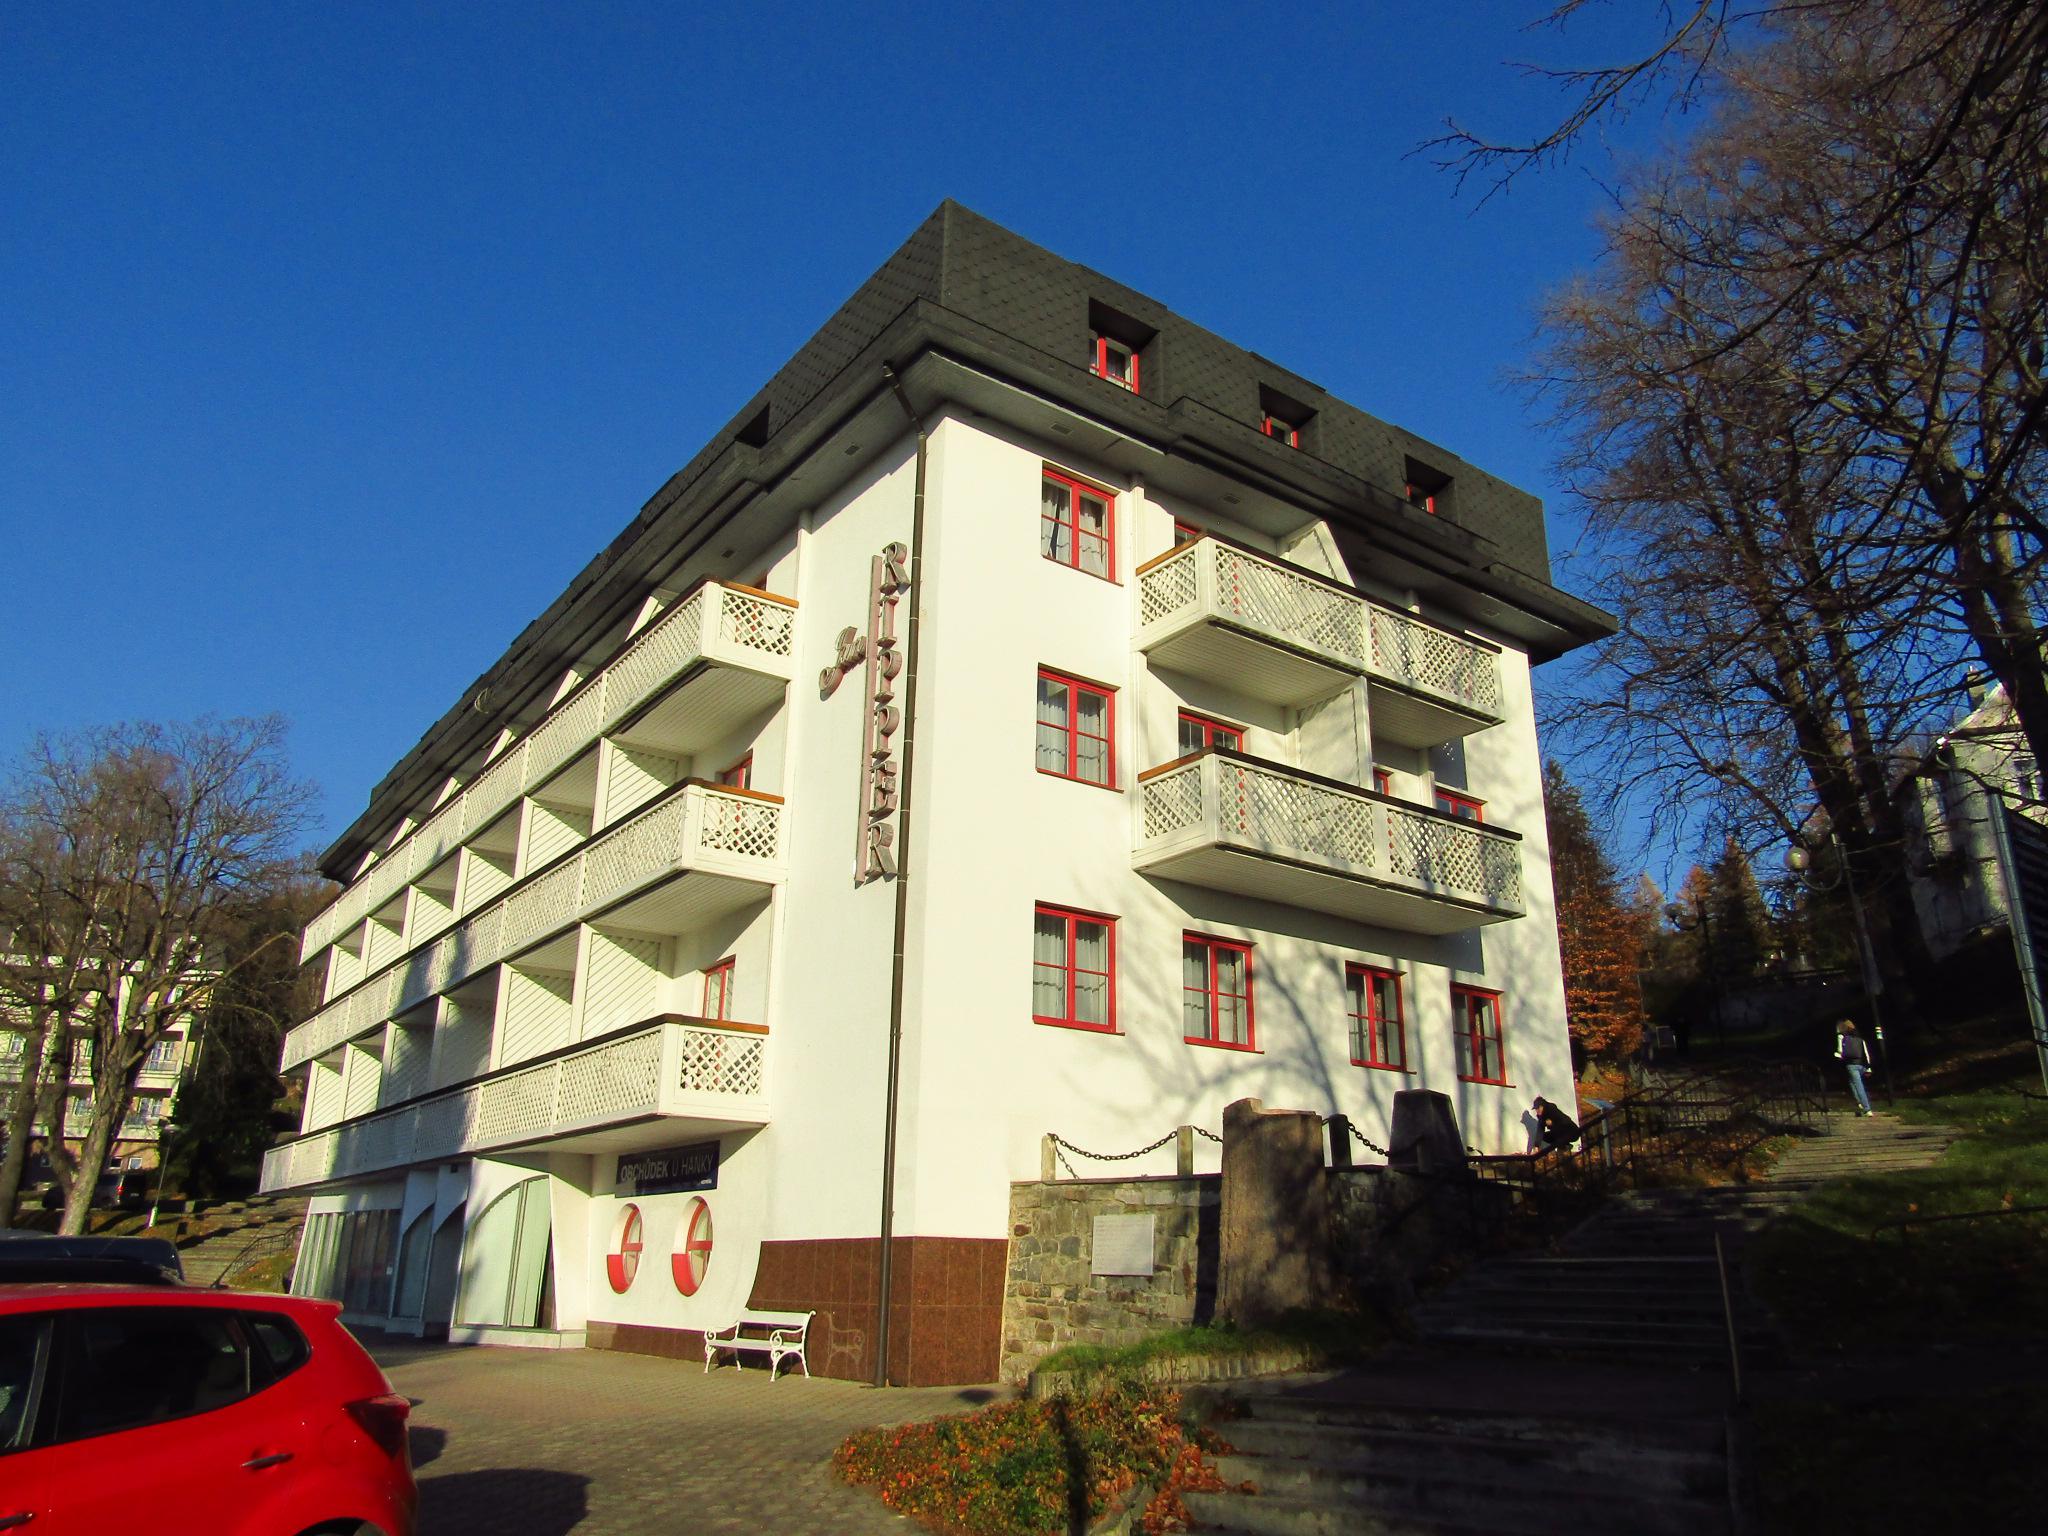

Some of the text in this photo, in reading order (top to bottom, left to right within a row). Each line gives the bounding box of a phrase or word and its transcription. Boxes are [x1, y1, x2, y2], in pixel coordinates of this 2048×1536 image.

[865, 541, 911, 885] RIPPER
[621, 1153, 714, 1181] OBCHŮDEK U HANKY
